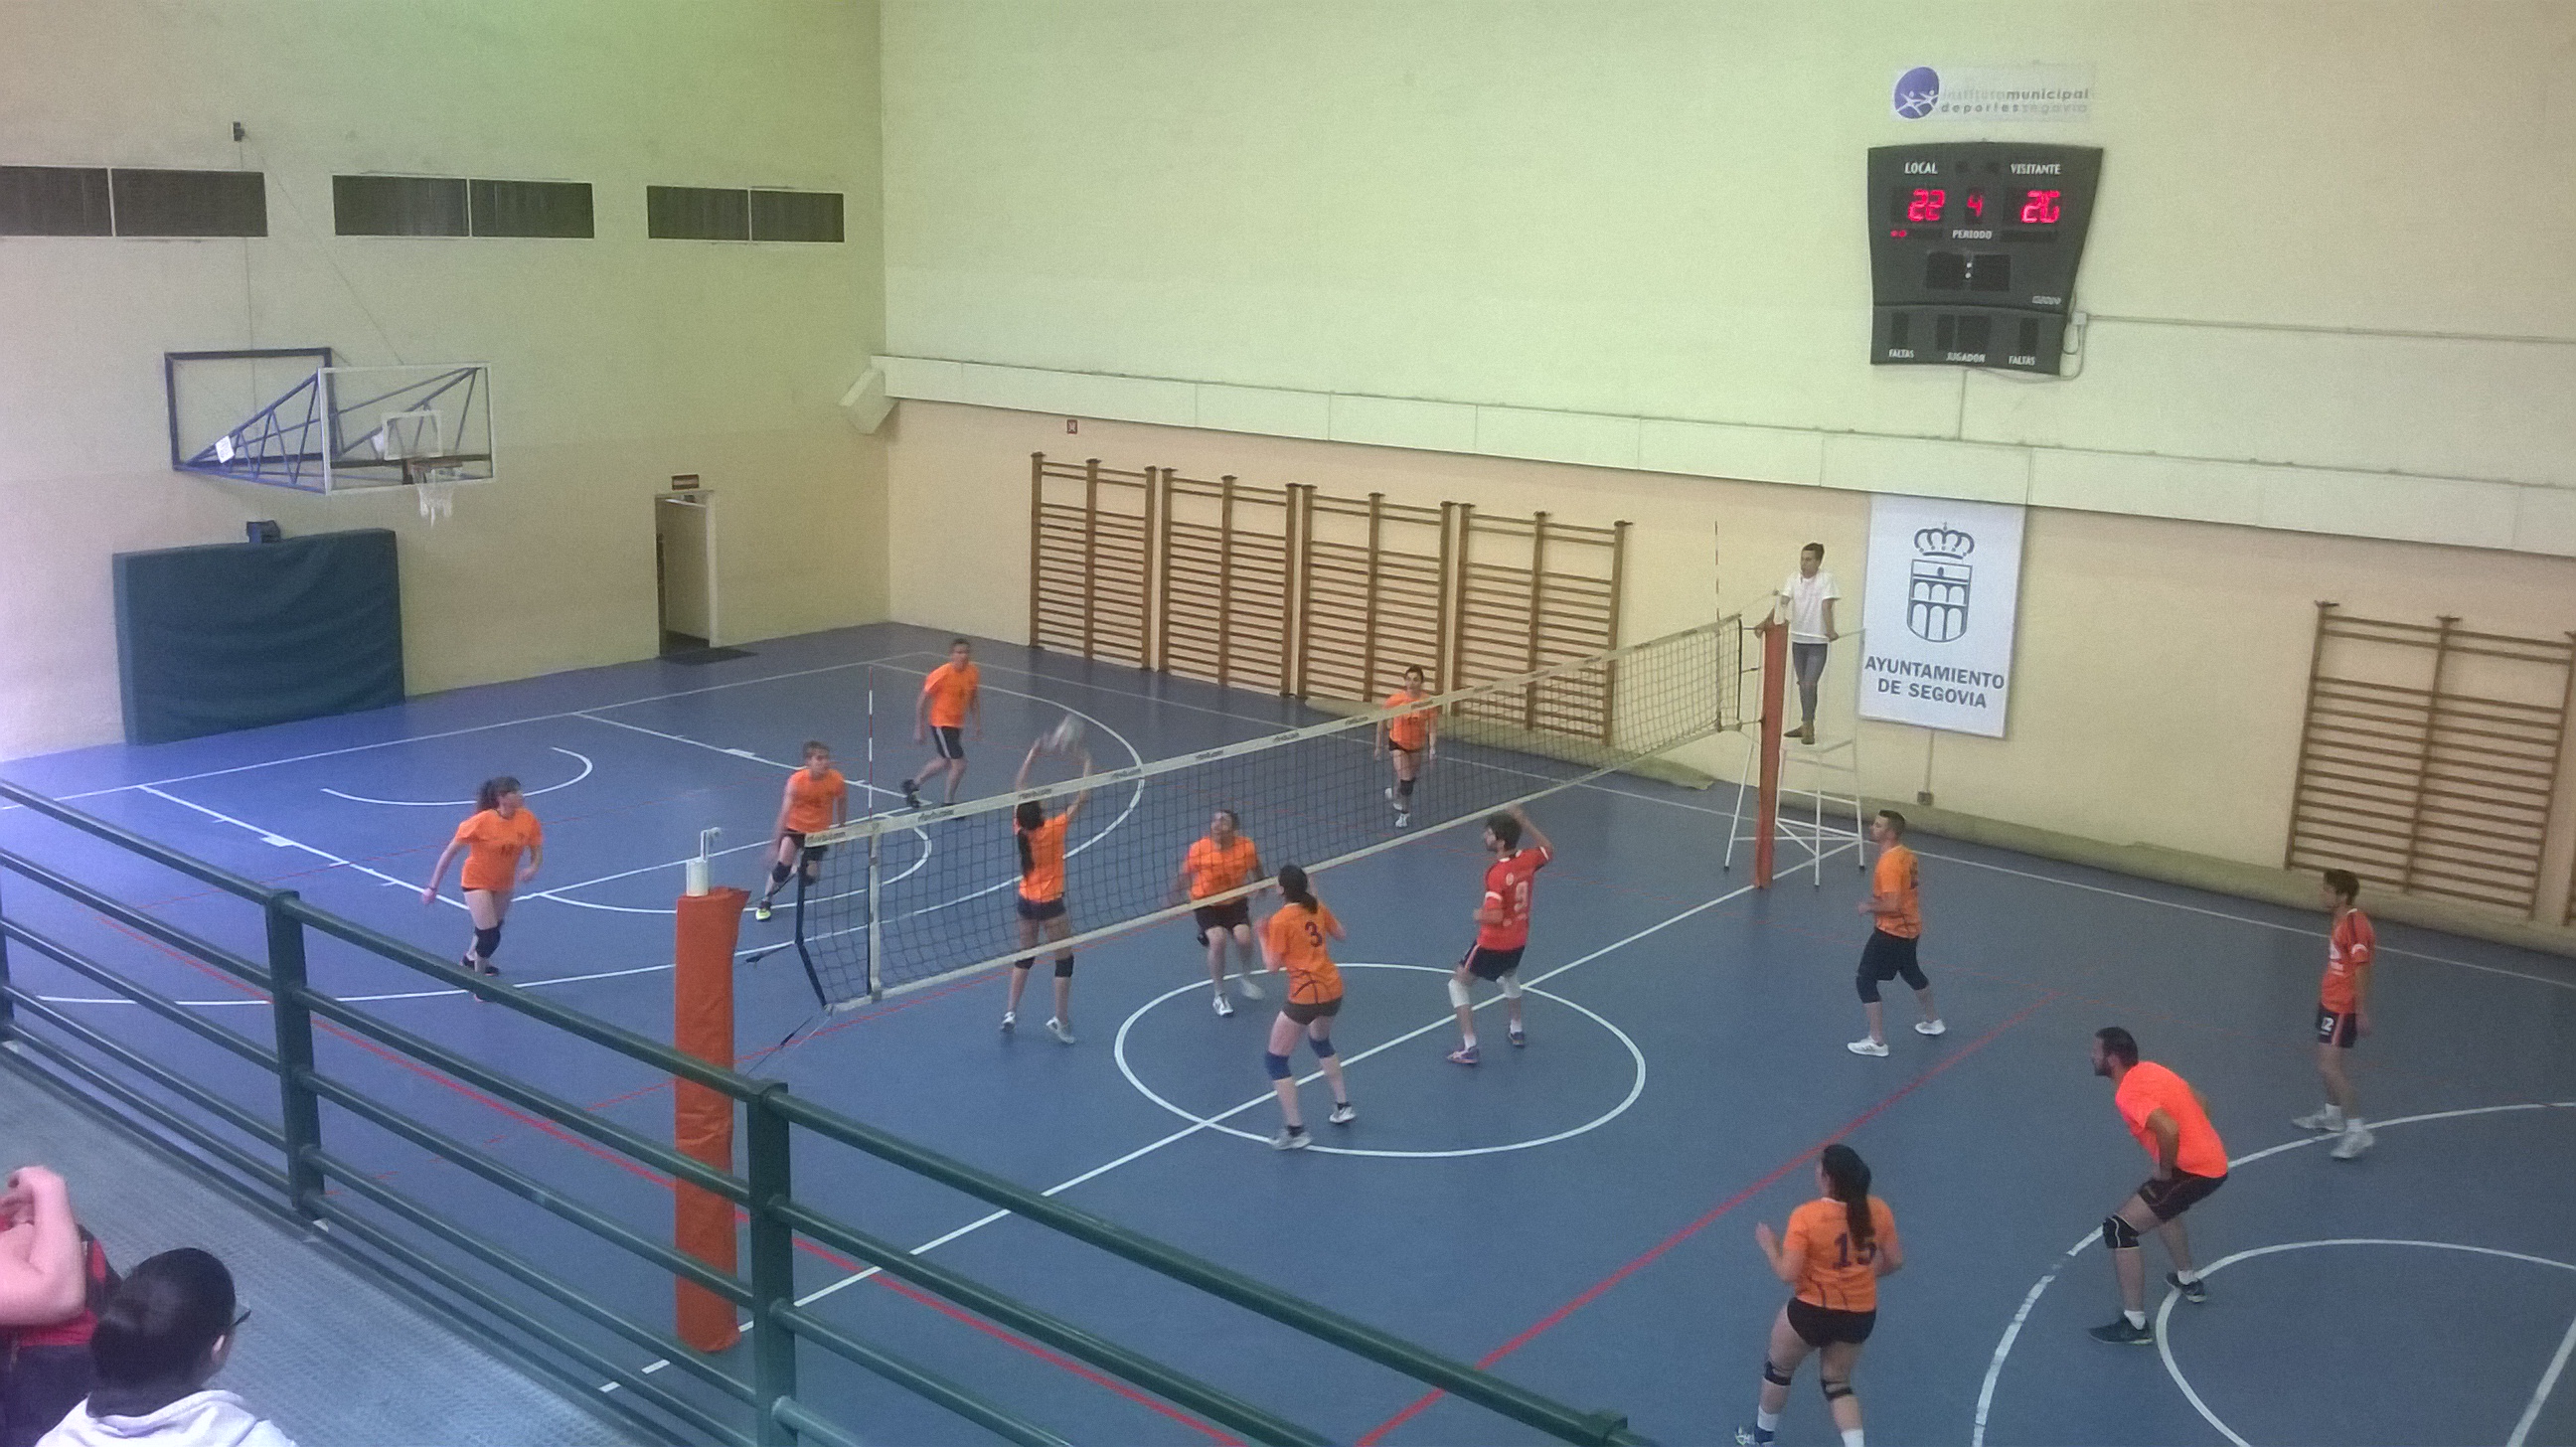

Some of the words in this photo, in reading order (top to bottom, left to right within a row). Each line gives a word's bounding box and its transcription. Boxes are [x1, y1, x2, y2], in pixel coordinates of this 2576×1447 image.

[1904, 162, 1938, 175] LOCAL
[2010, 163, 2062, 175] VISITANTE
[1907, 188, 1946, 222] 22
[1967, 193, 1984, 218] 4
[1952, 230, 1993, 240] PERIODO
[1888, 349, 1915, 359] FALTAS
[2008, 355, 2036, 366] FALTAS
[1864, 655, 2005, 690] AYUNTAMIENTO
[1877, 678, 1902, 696] DE
[1907, 683, 1987, 709] SEGOVIA
[1304, 921, 1323, 947] 3
